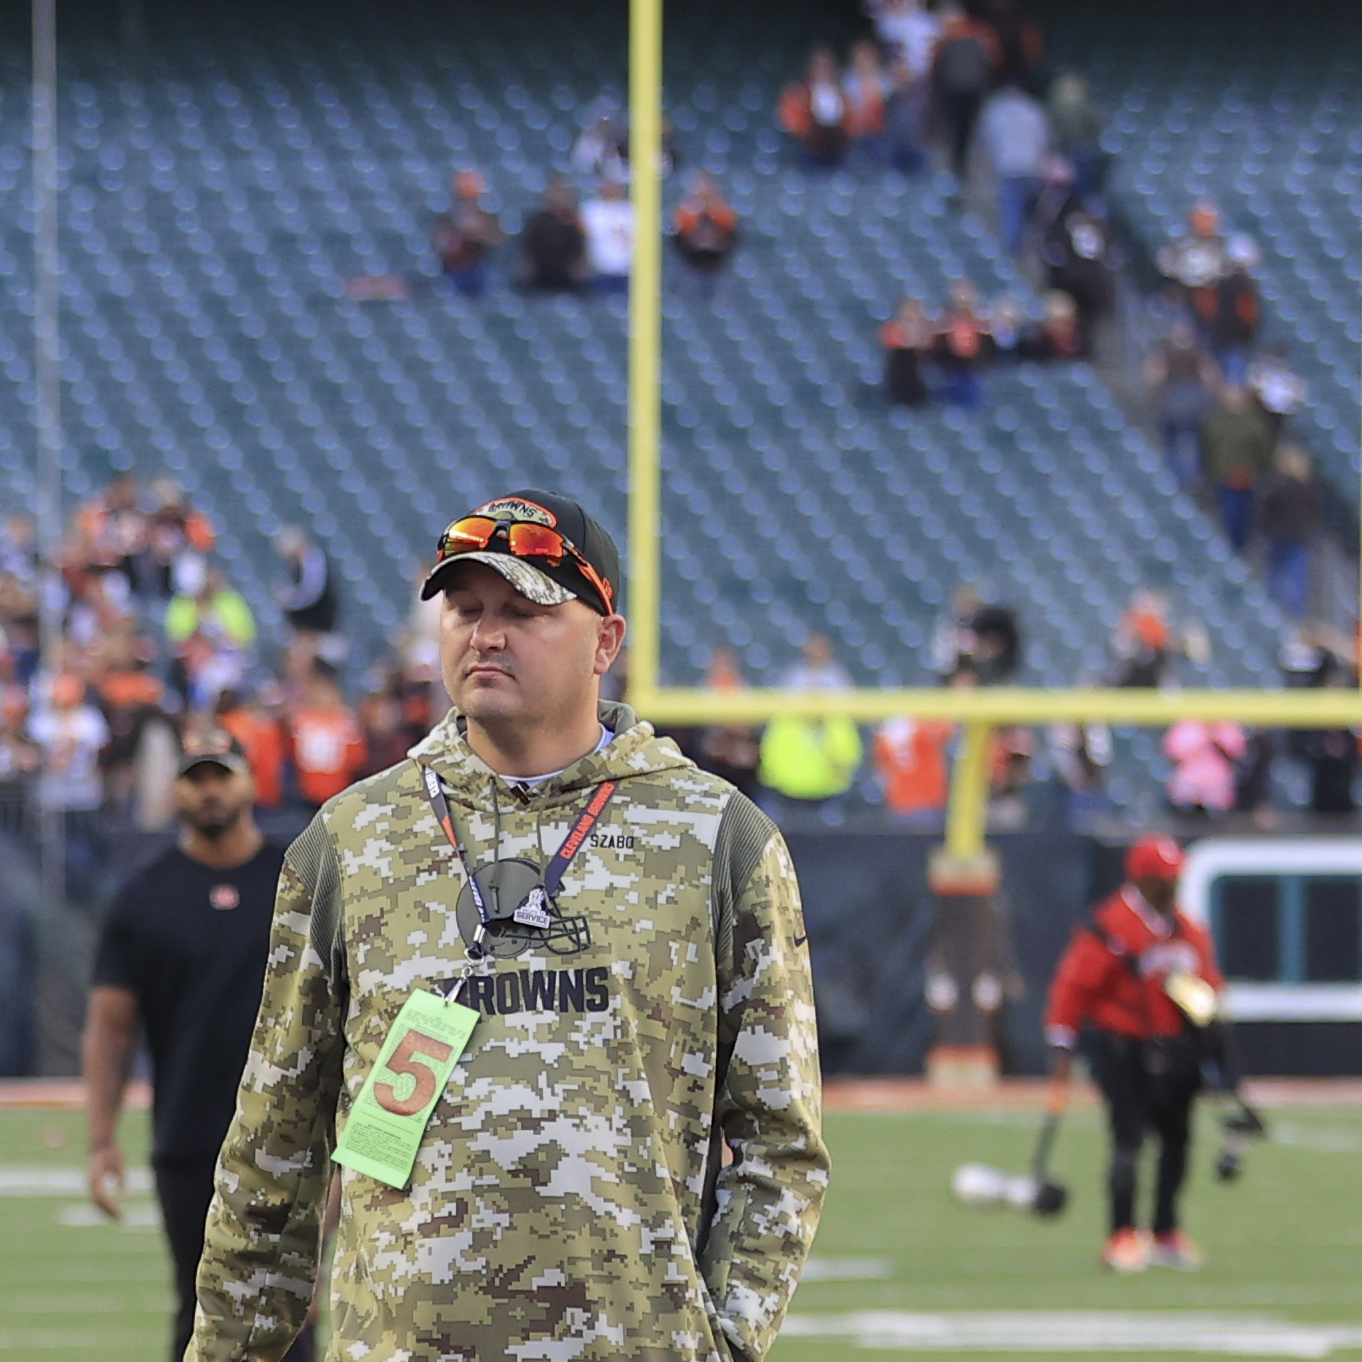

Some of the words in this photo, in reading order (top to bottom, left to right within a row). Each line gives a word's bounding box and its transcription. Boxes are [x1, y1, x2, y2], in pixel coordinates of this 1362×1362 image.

[559, 813, 595, 859] CLEVELAND
[587, 781, 615, 816] BROWNS
[589, 833, 635, 849] SZABO
[516, 911, 549, 924] SERVICE
[374, 1028, 455, 1117] 5
